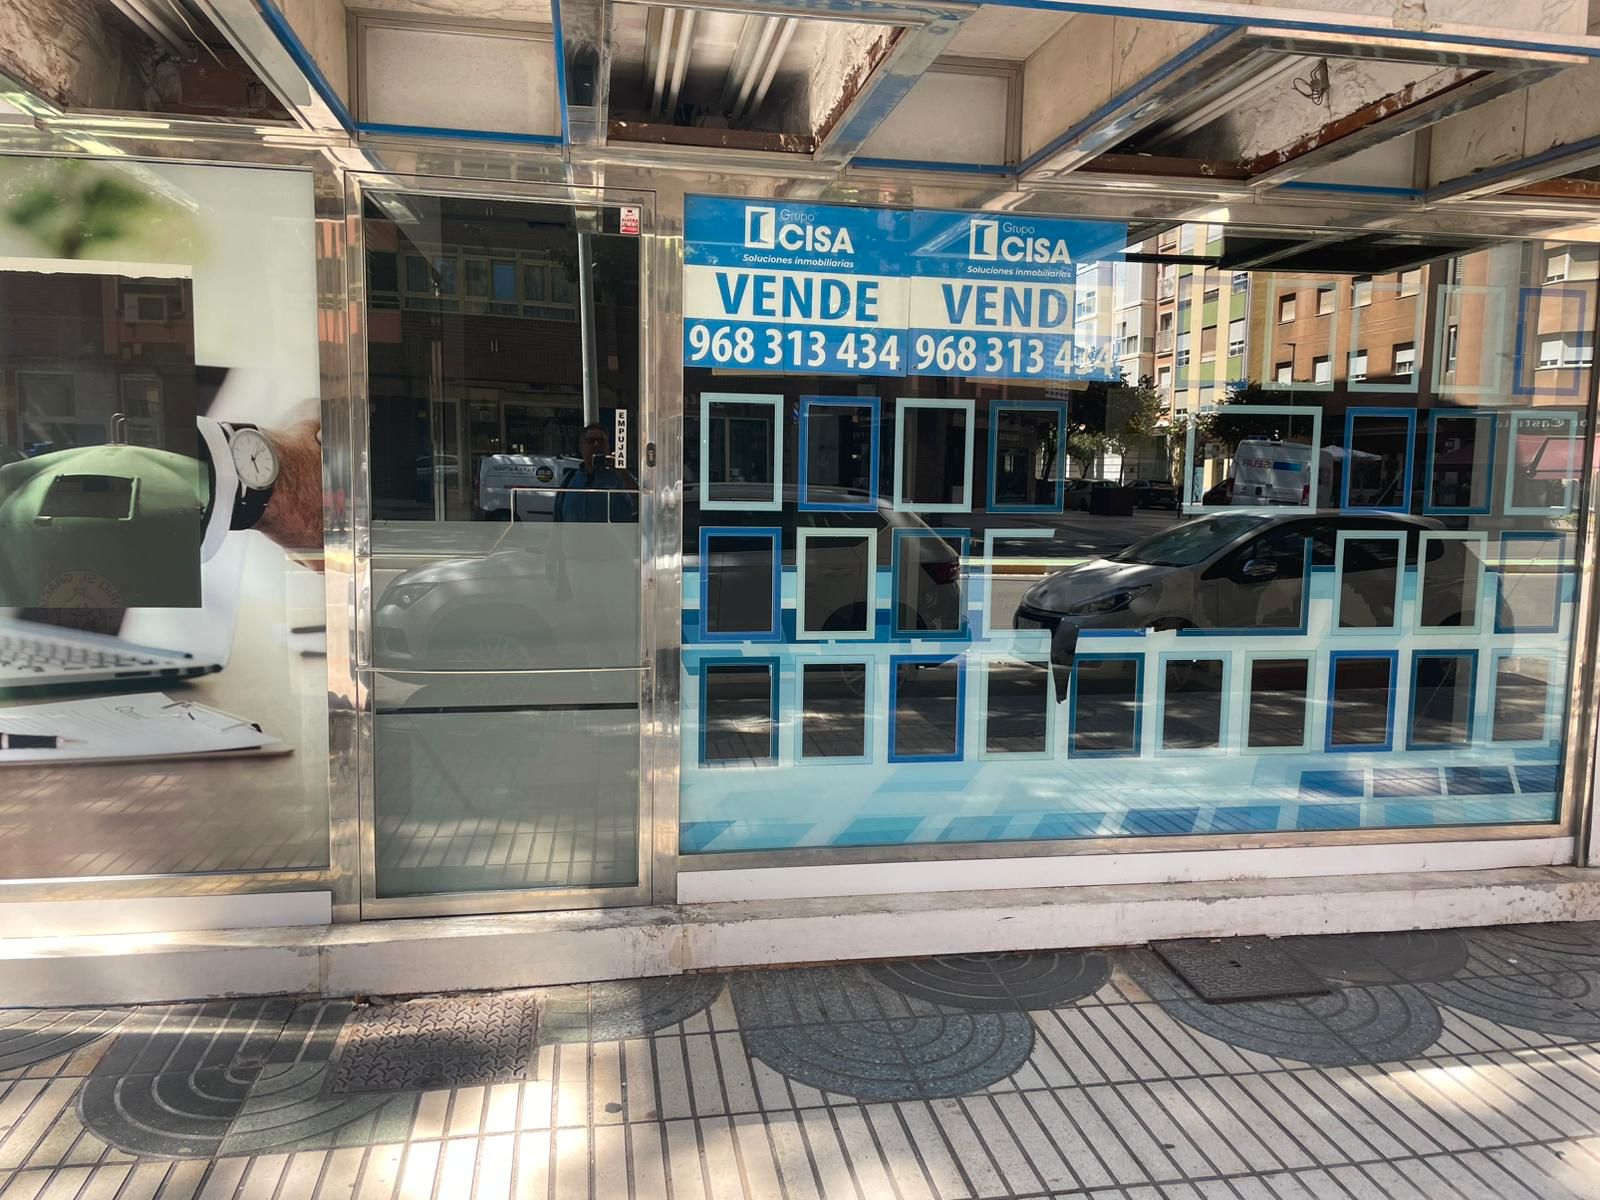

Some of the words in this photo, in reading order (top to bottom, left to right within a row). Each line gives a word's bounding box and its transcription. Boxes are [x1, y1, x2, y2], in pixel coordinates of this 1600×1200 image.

[780, 209, 815, 223] Grupo
[1002, 221, 1035, 235] Grupo
[779, 223, 854, 254] CISA
[1001, 236, 1072, 264] CISA
[742, 253, 793, 265] Soluciones
[795, 256, 854, 268] inmobiliarias
[967, 265, 1014, 276] Soluciones
[1015, 267, 1071, 278] inmobiliarias
[715, 272, 880, 323] VENDE
[941, 283, 1077, 329] VEND
[689, 324, 755, 363] 968
[764, 329, 826, 366] 313
[837, 332, 900, 370] 434
[915, 334, 977, 371] 968
[985, 338, 1045, 374] 313
[617, 412, 626, 467] EMPUJAR
